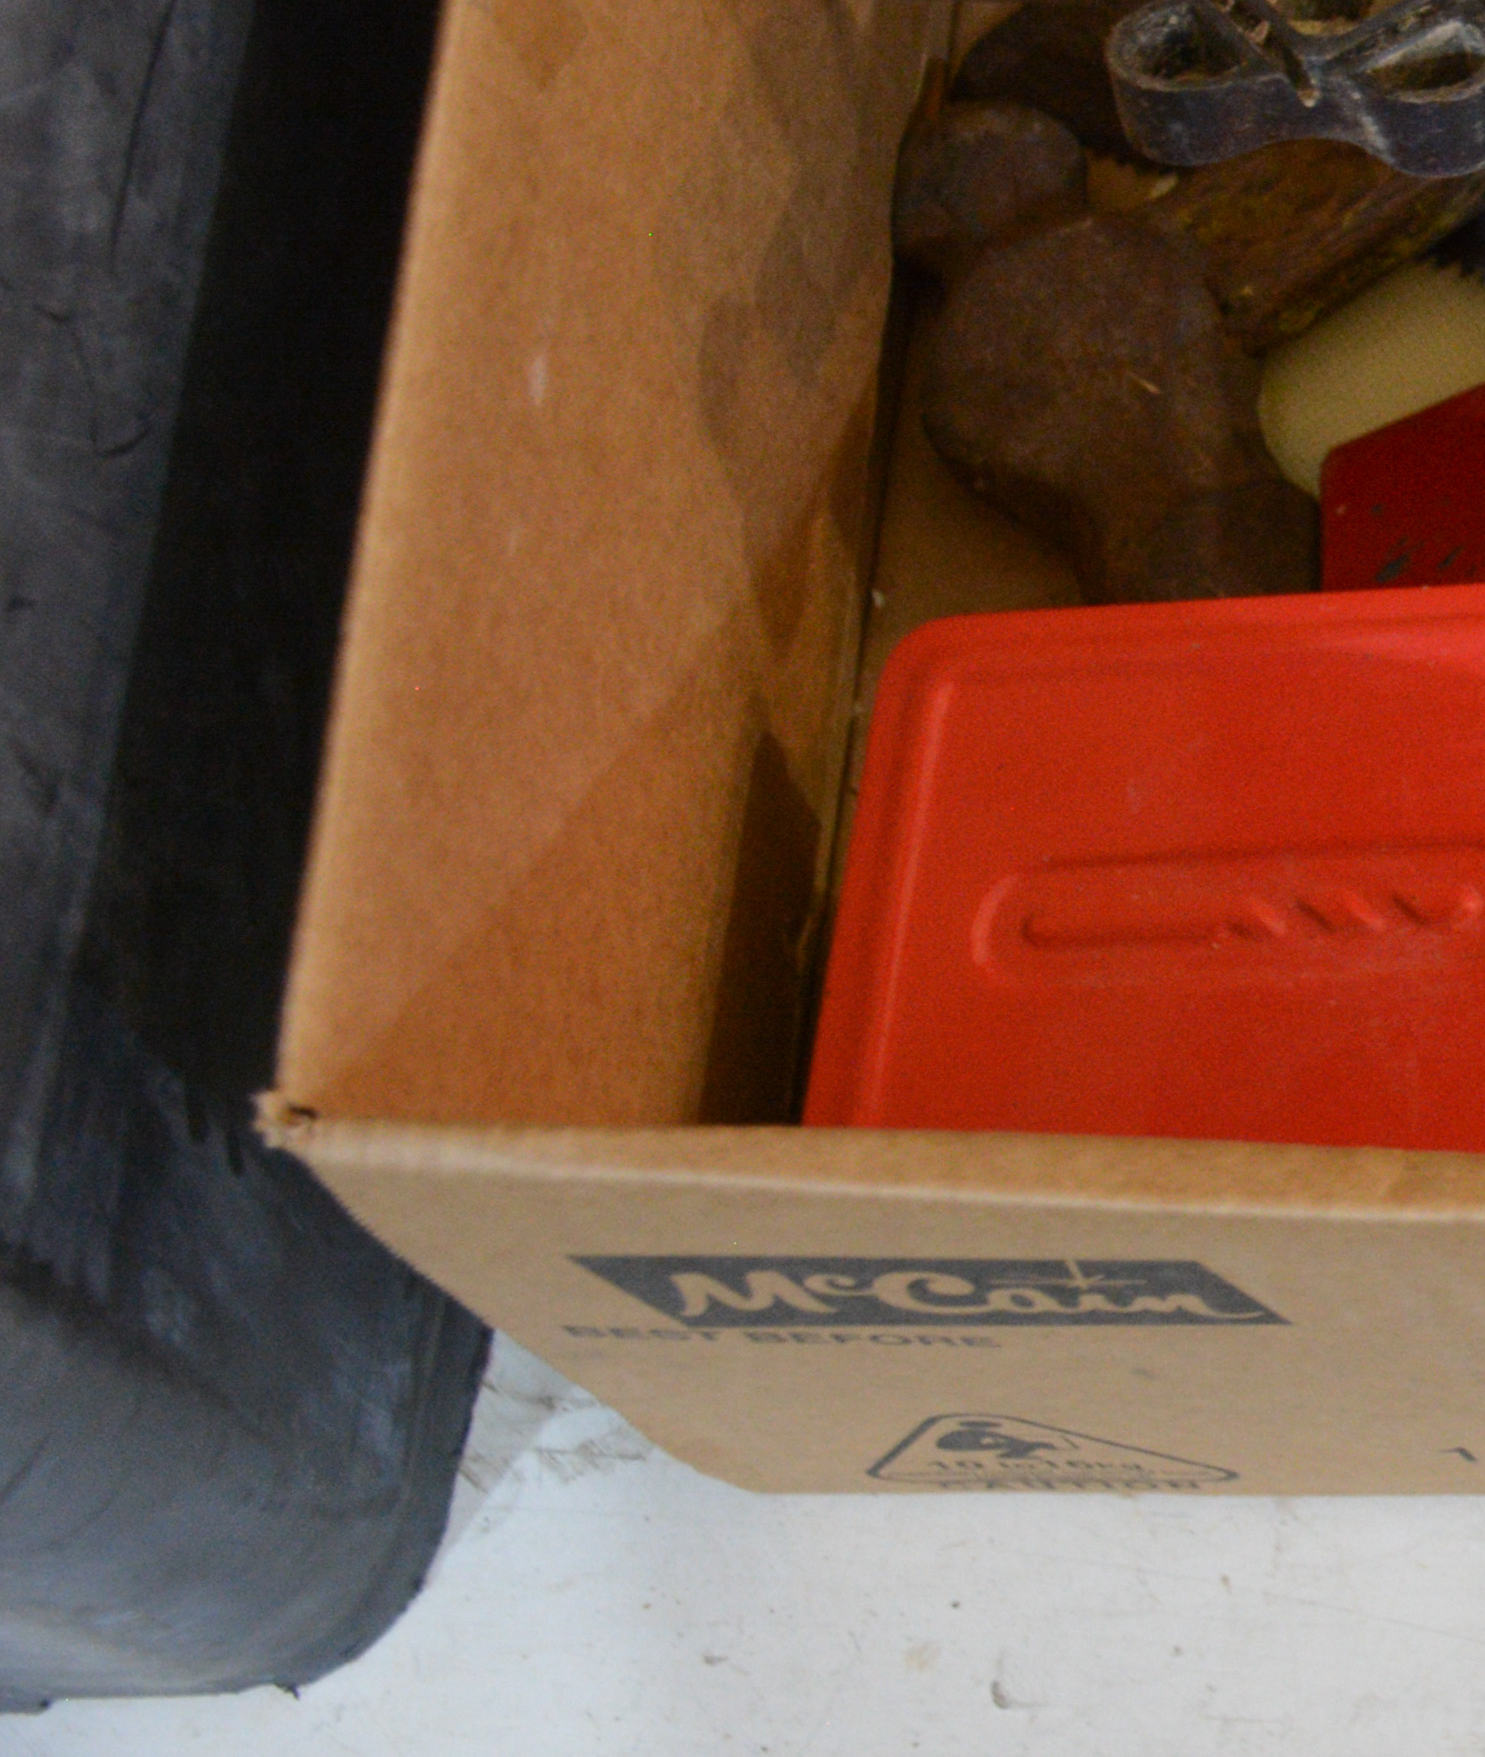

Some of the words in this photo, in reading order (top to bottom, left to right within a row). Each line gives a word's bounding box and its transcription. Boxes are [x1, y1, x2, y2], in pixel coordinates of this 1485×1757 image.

[668, 1268, 1270, 1319] McCain
[562, 1325, 723, 1342] BEST
[744, 1331, 1003, 1348] BEFORE
